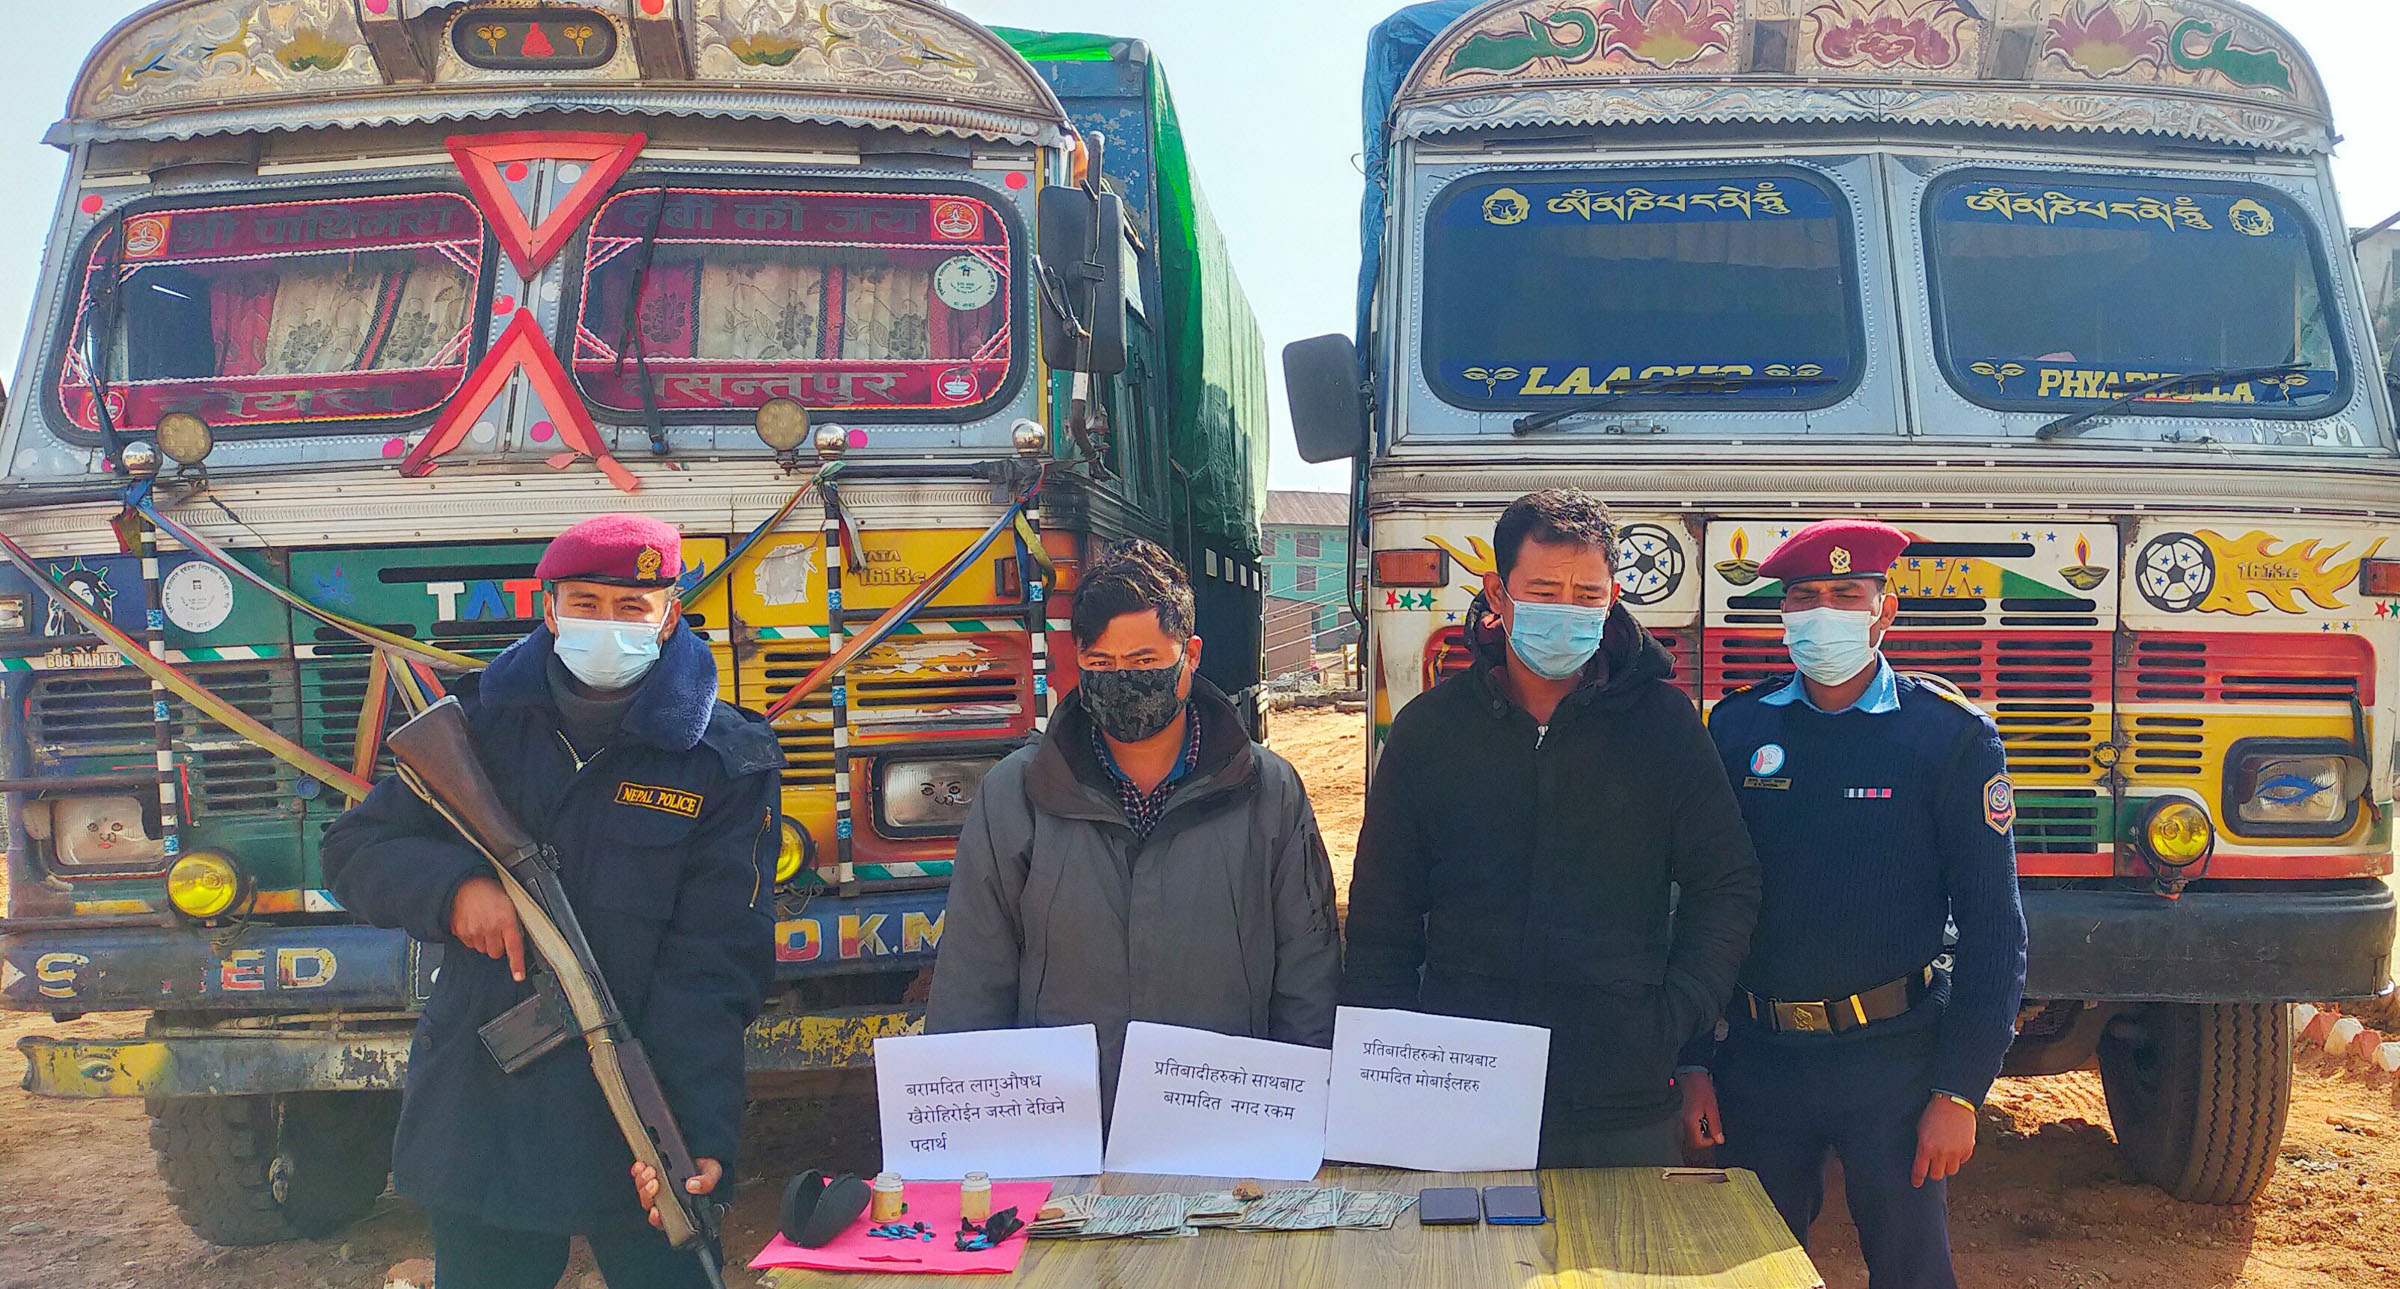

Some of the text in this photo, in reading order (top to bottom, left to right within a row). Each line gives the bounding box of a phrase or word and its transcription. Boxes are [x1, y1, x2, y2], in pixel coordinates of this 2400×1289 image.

[816, 205, 920, 234] जय
[47, 652, 120, 668] BOB MARLEY
[622, 787, 697, 813] NEPAL POLICE
[1362, 1039, 1498, 1069] प्रतिबादीहरुको साथबाट
[904, 1071, 1043, 1098] बरामदित लागुऔषध
[1154, 1057, 1306, 1093] प्रतिबादीहरुको साथबाट
[1360, 1066, 1481, 1092] बरामदित मोबाईलहरु
[907, 1096, 1066, 1125] खैरोहिरोईन जस्तो देखिने
[1163, 1089, 1296, 1120] बरामदित नगद रकम
[909, 1131, 948, 1153] पदार्थ
